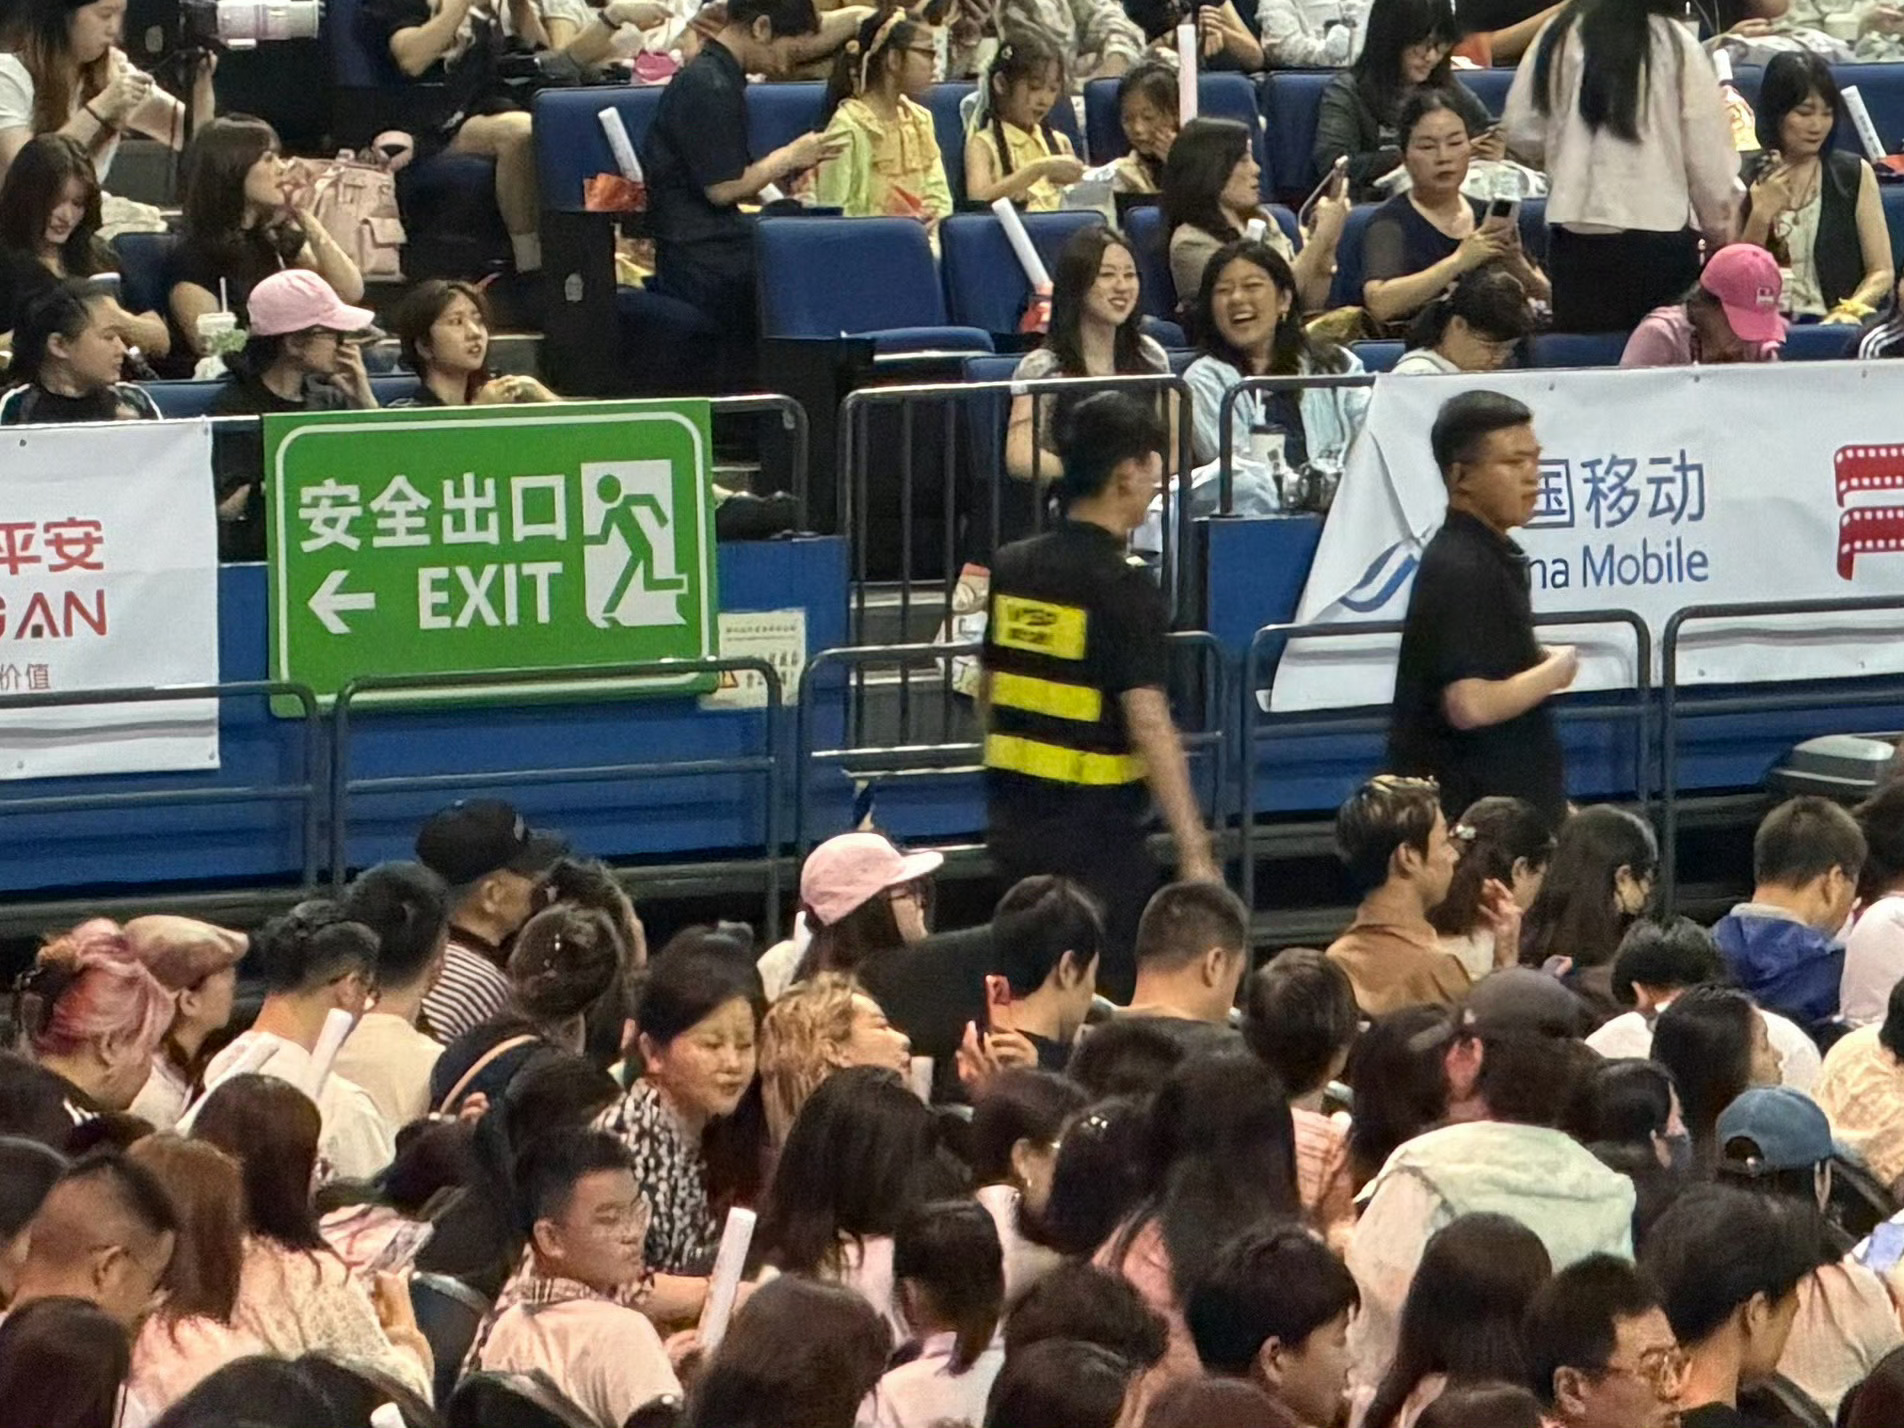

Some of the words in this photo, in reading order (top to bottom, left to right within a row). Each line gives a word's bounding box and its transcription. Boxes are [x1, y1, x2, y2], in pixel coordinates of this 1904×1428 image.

[299, 473, 568, 553] 安全出口
[0, 517, 104, 575] 平安
[1583, 536, 1709, 588] Mobile
[0, 589, 108, 640] AN
[418, 561, 563, 630] EXIT
